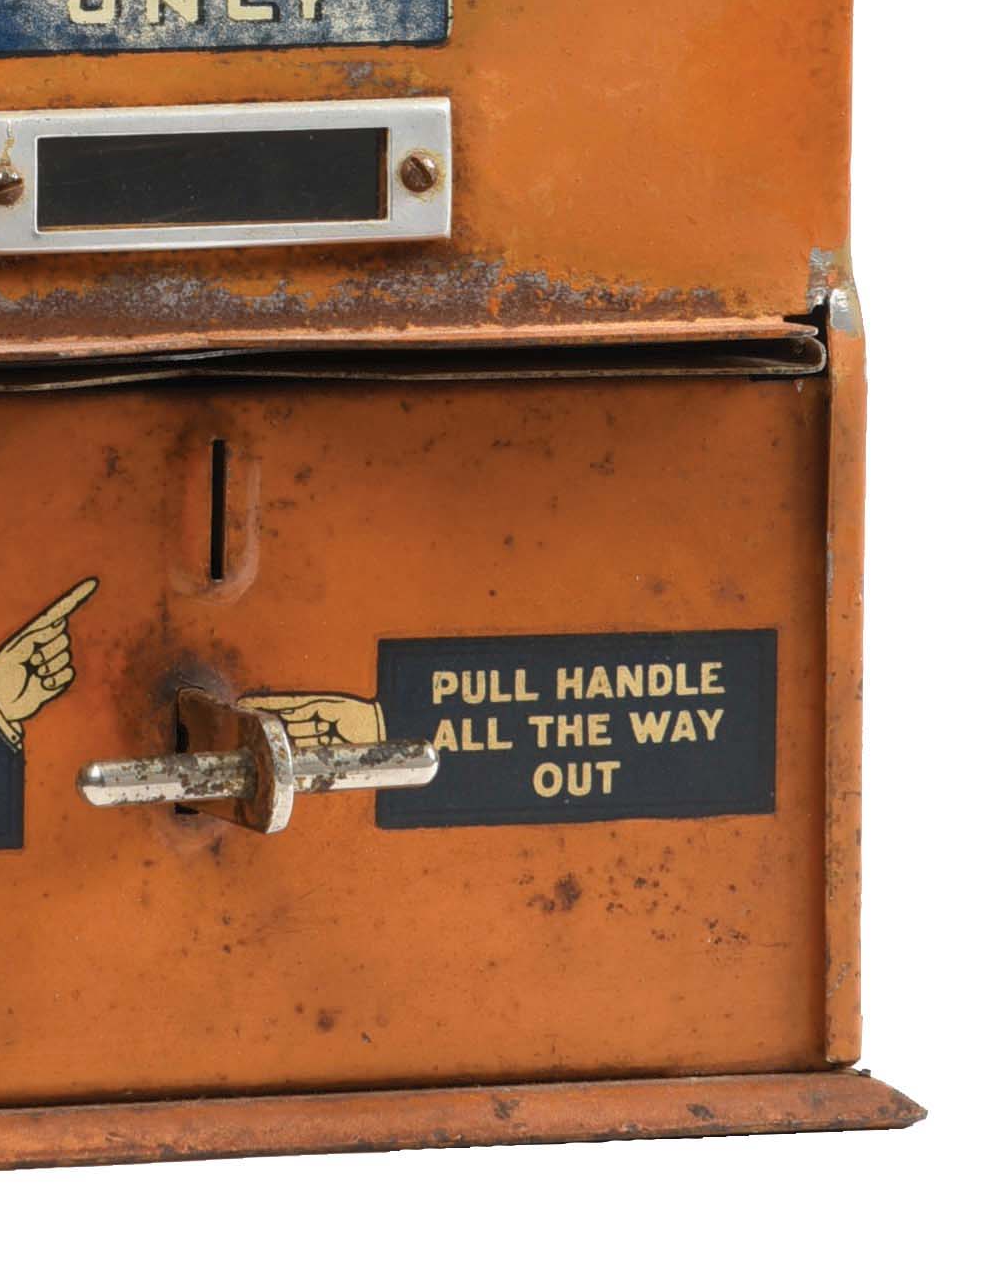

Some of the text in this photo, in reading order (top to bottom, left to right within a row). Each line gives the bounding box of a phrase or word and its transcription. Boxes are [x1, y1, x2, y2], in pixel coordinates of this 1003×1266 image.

[431, 661, 726, 705] PULL HANDLE
[432, 709, 724, 752] ALL THE WAY
[533, 761, 621, 799] OUT
